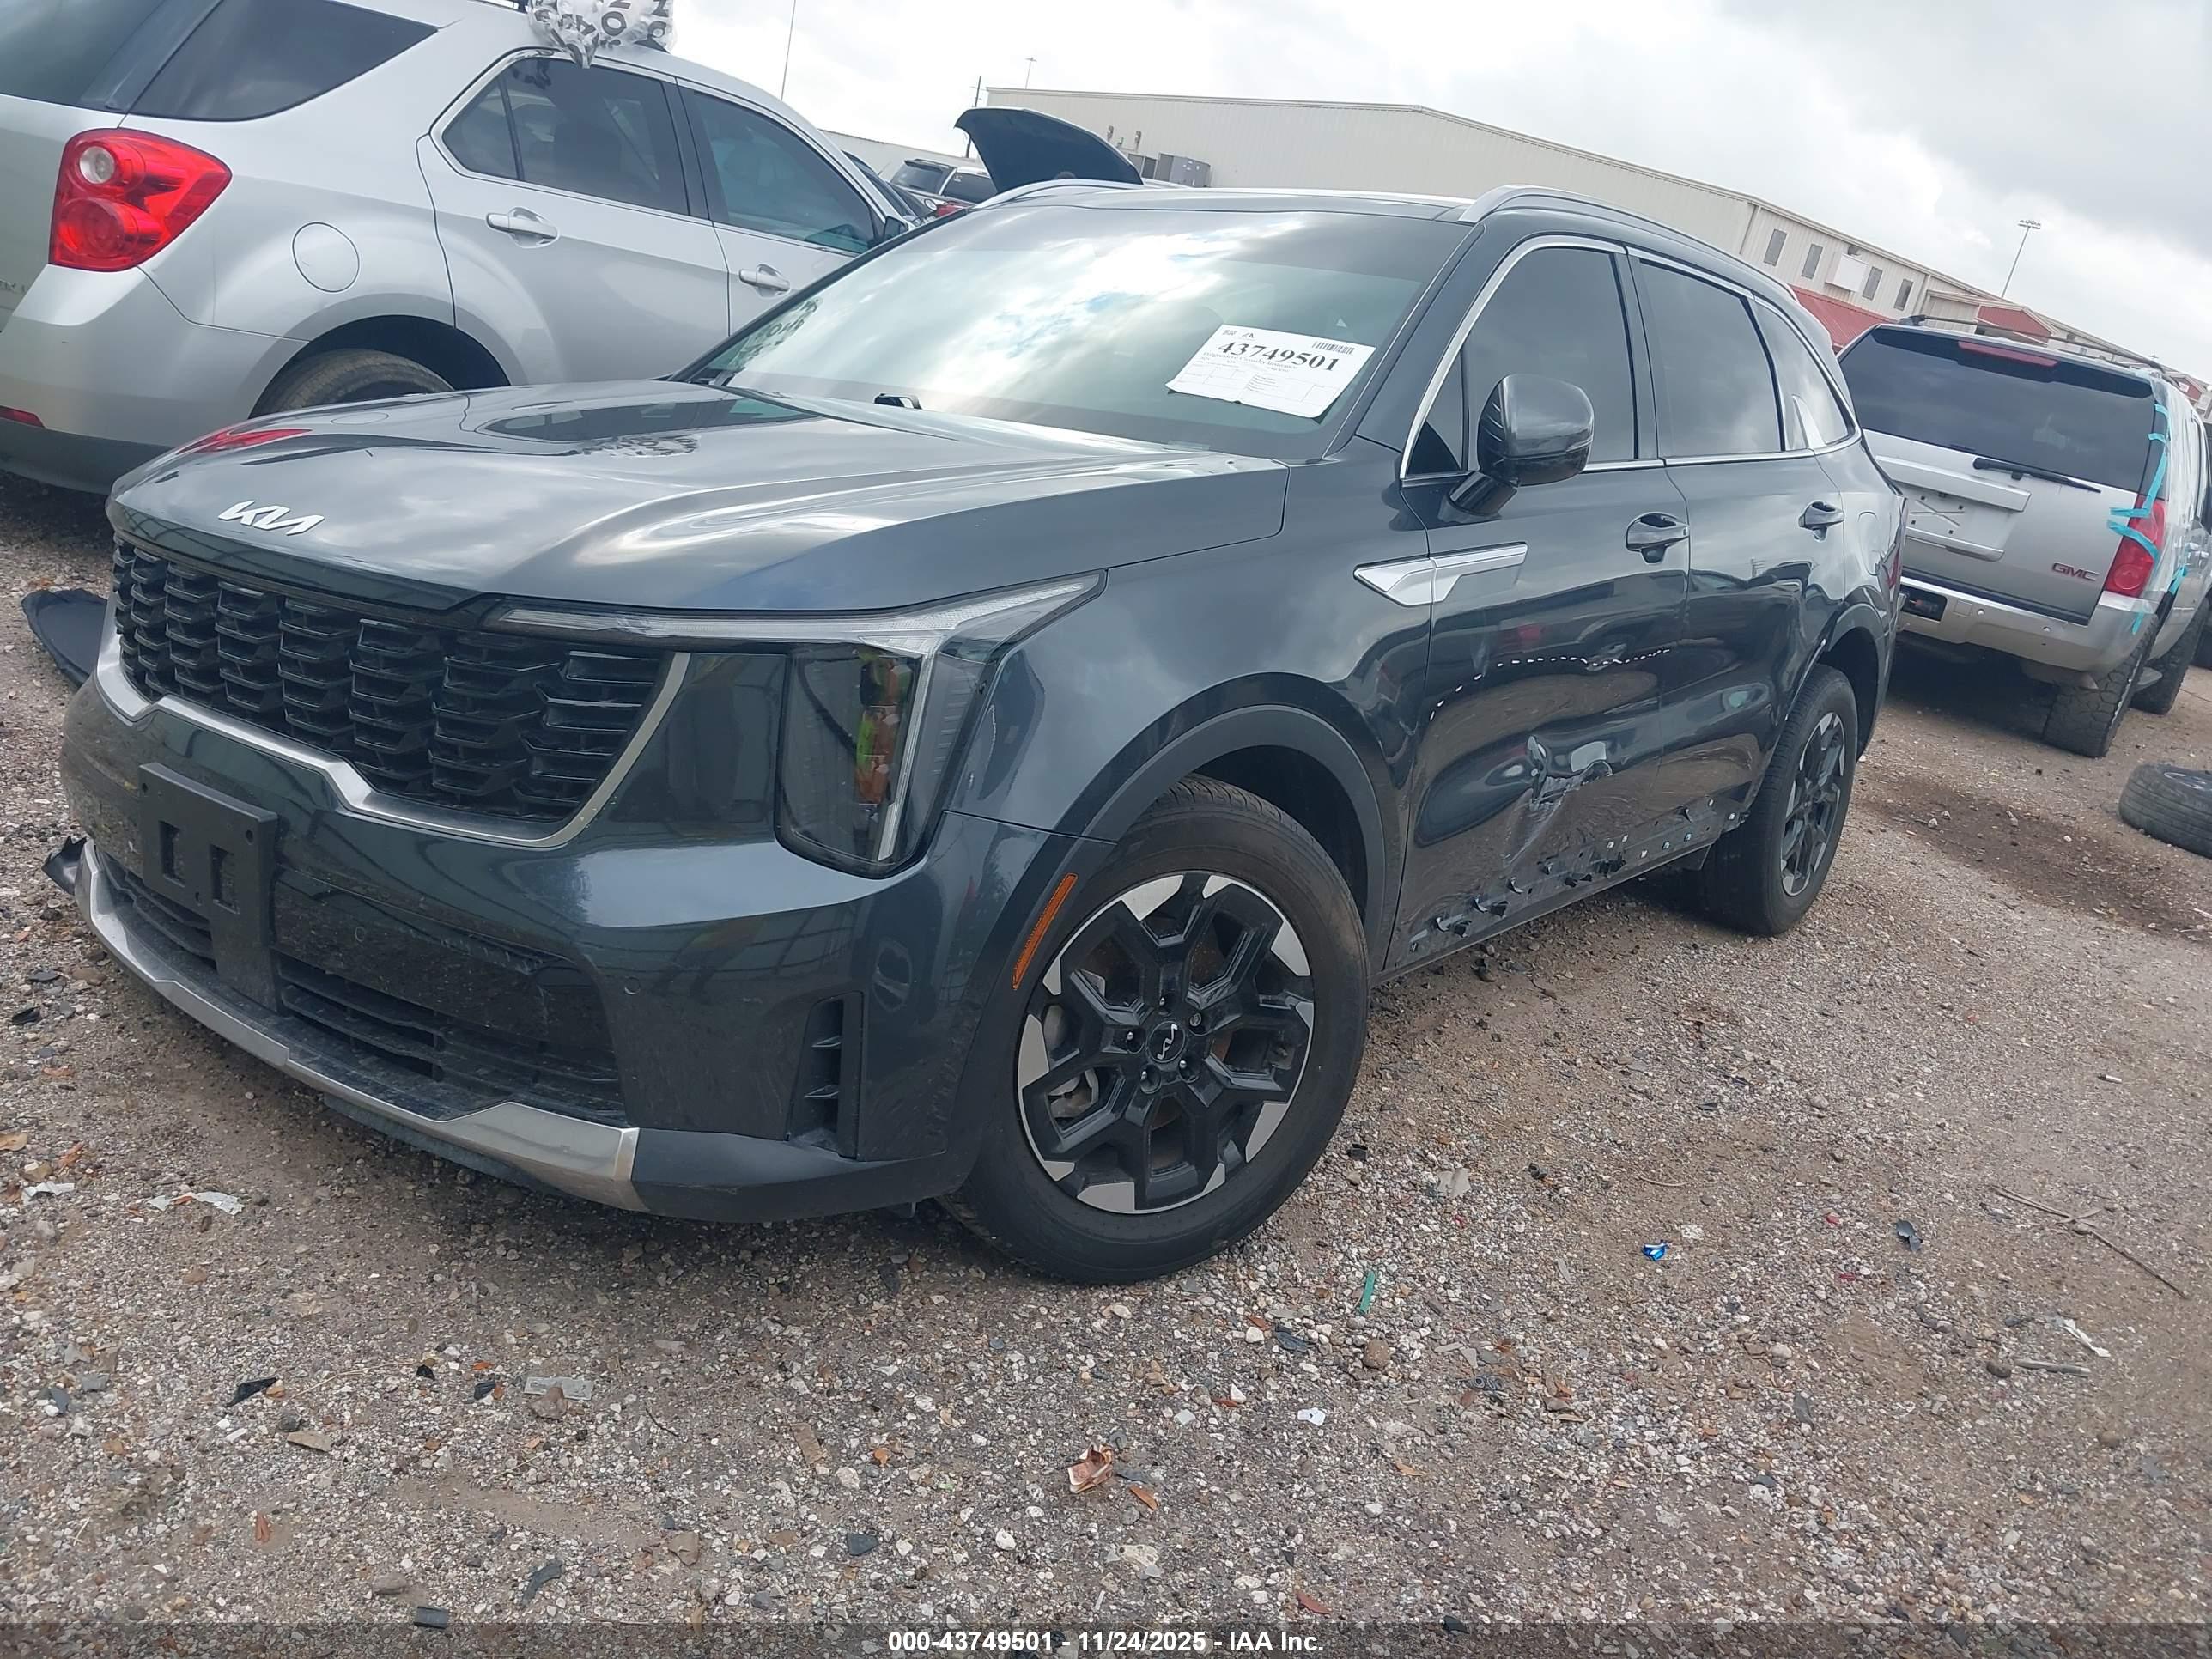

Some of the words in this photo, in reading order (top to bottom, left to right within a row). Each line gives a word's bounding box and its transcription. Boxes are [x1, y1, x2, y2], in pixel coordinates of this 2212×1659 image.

[1218, 342, 1340, 371] 43749501
[218, 500, 325, 536] KIA
[2052, 562, 2100, 581] GMC
